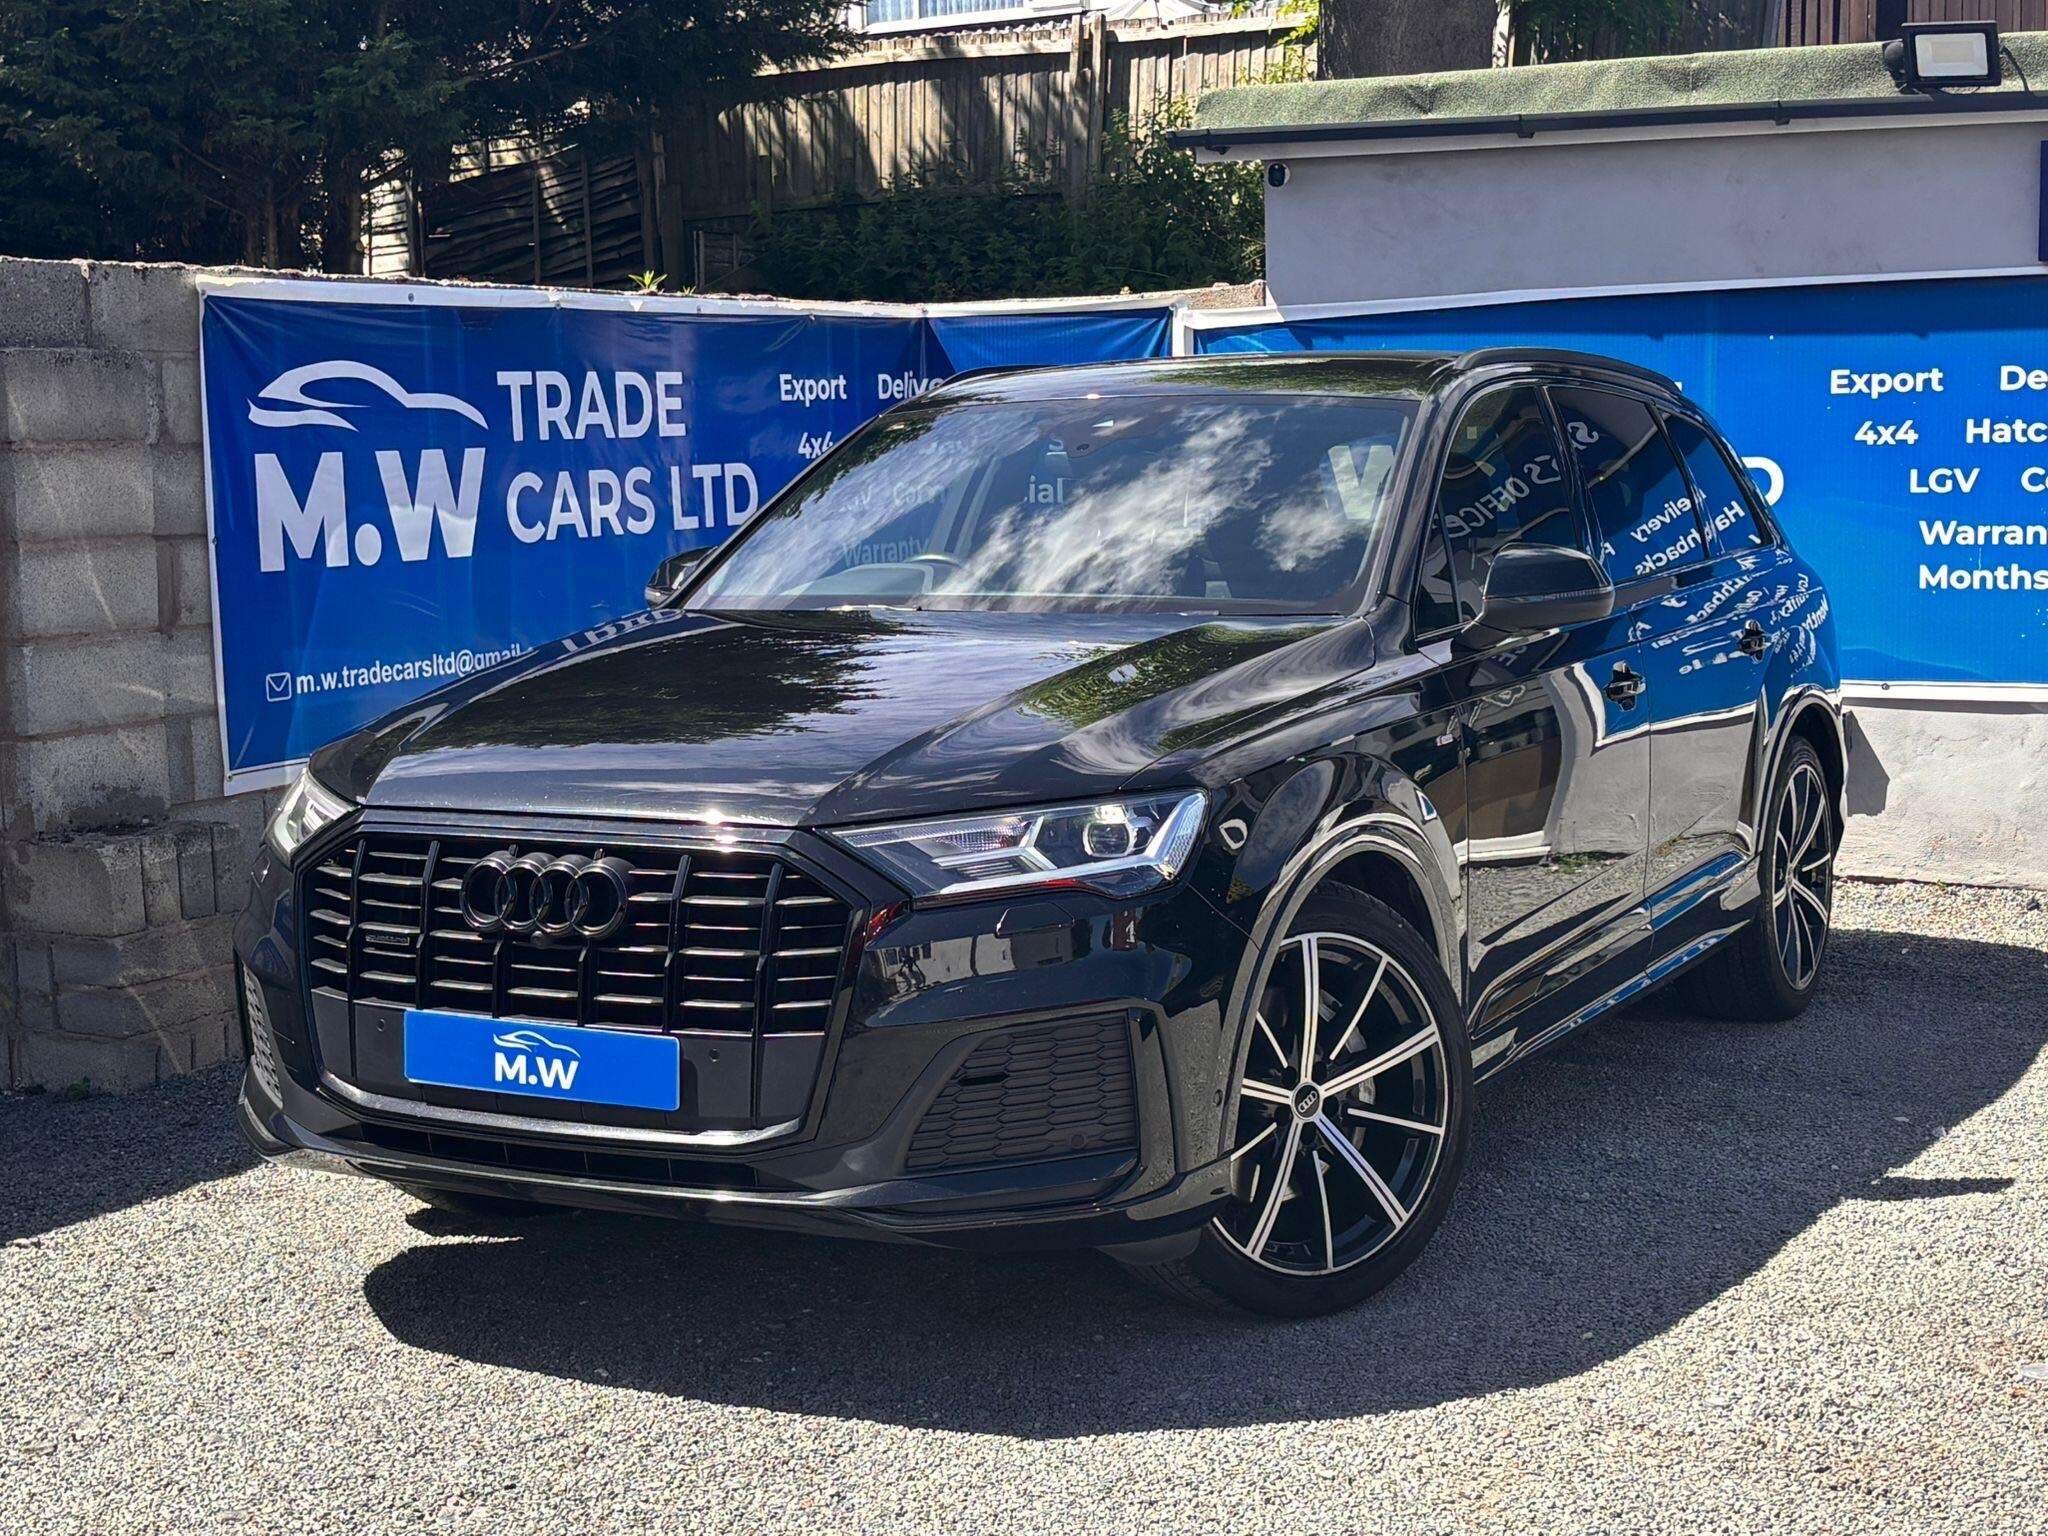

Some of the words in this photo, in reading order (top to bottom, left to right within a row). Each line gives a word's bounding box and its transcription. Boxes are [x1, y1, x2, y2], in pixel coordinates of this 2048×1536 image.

[779, 373, 847, 407] Export
[1831, 368, 1943, 399] Export
[497, 371, 686, 442] TRADE
[798, 432, 834, 459] 4x4
[1854, 420, 1919, 445] 4x4
[1966, 418, 2048, 443] Hatc
[1910, 468, 1980, 493] LGV
[255, 448, 485, 573] M.W
[507, 467, 657, 543] CARS
[671, 463, 760, 530] LTD
[1919, 520, 2048, 545] Warran
[1919, 563, 2048, 590] Months
[296, 643, 534, 694] m.w.tradecarsltd@gmail
[494, 1052, 580, 1090] M.W
